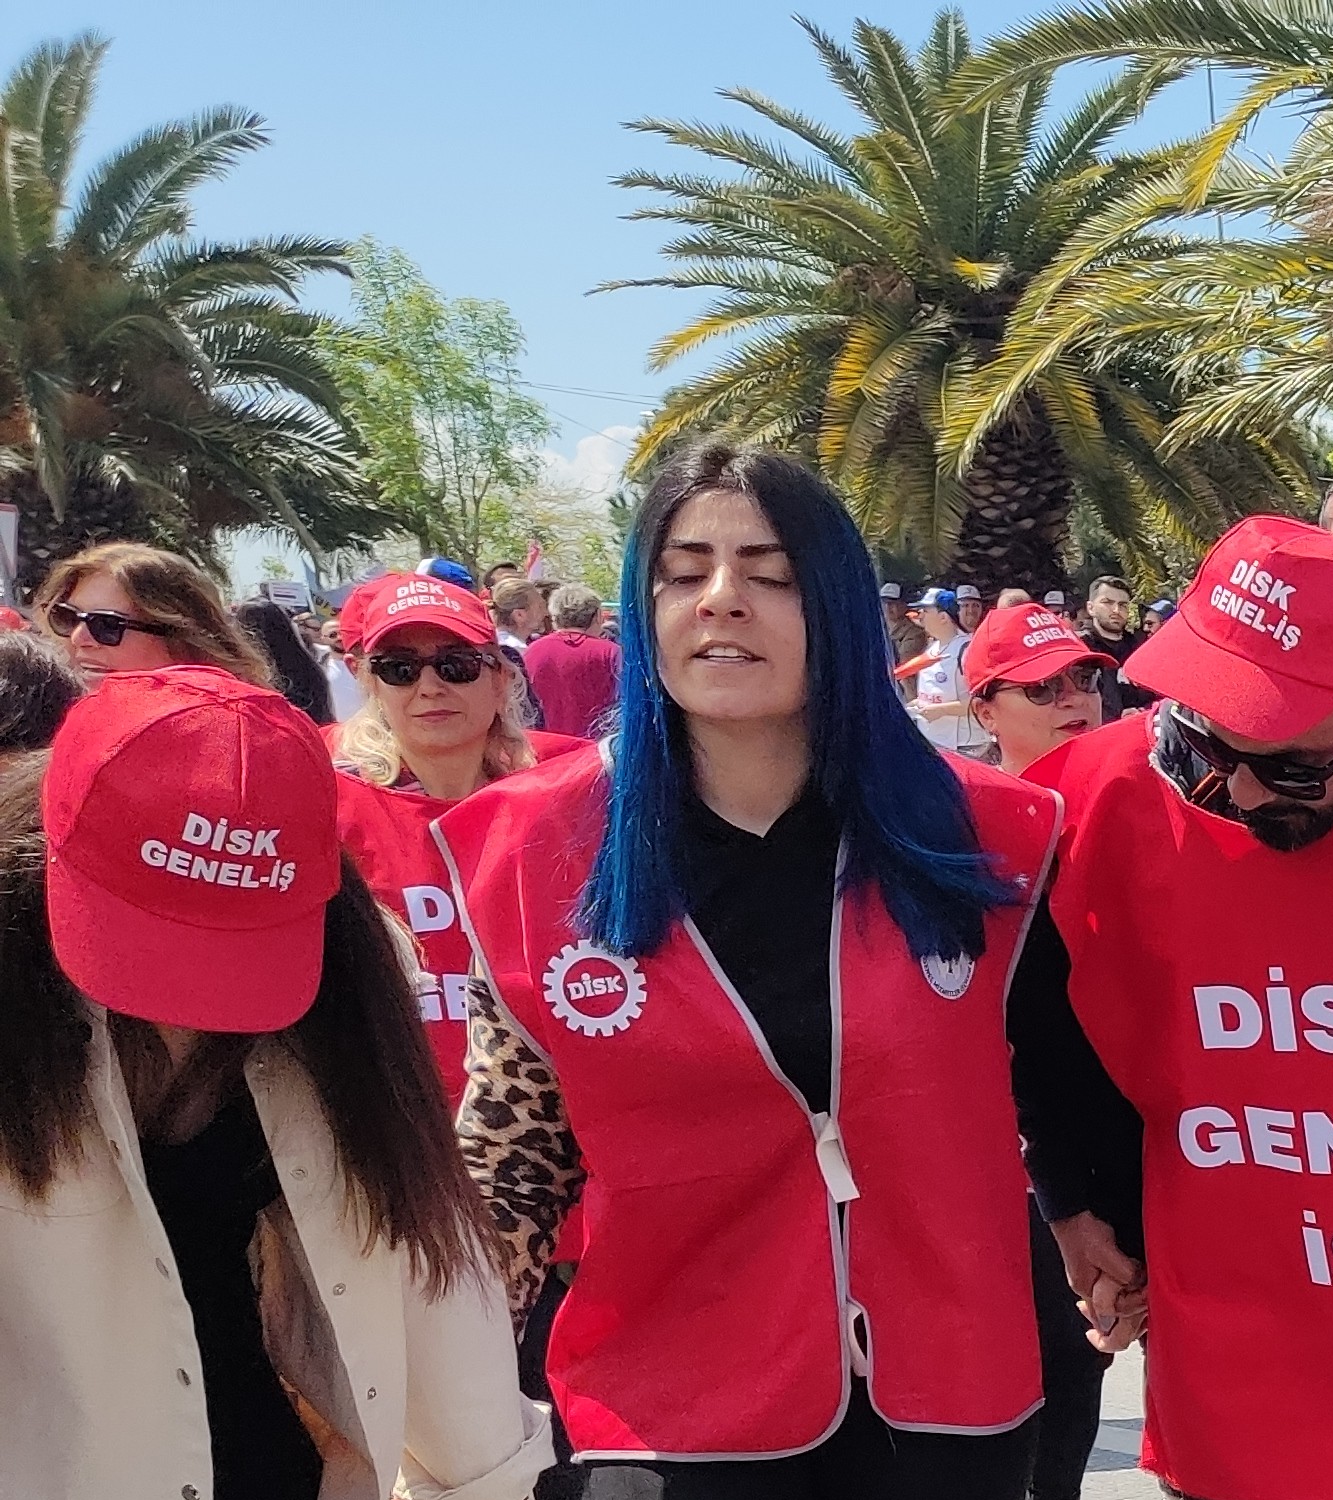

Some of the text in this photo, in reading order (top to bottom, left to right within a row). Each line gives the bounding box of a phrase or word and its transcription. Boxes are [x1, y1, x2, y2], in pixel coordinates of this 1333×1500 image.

[396, 581, 445, 599] DİSK
[1229, 559, 1297, 612] DİSK
[1210, 584, 1301, 651] GENEL-İŞ
[182, 812, 281, 857] DİSK
[140, 839, 297, 893] GENEL-İŞ
[566, 972, 624, 1000] DİSK
